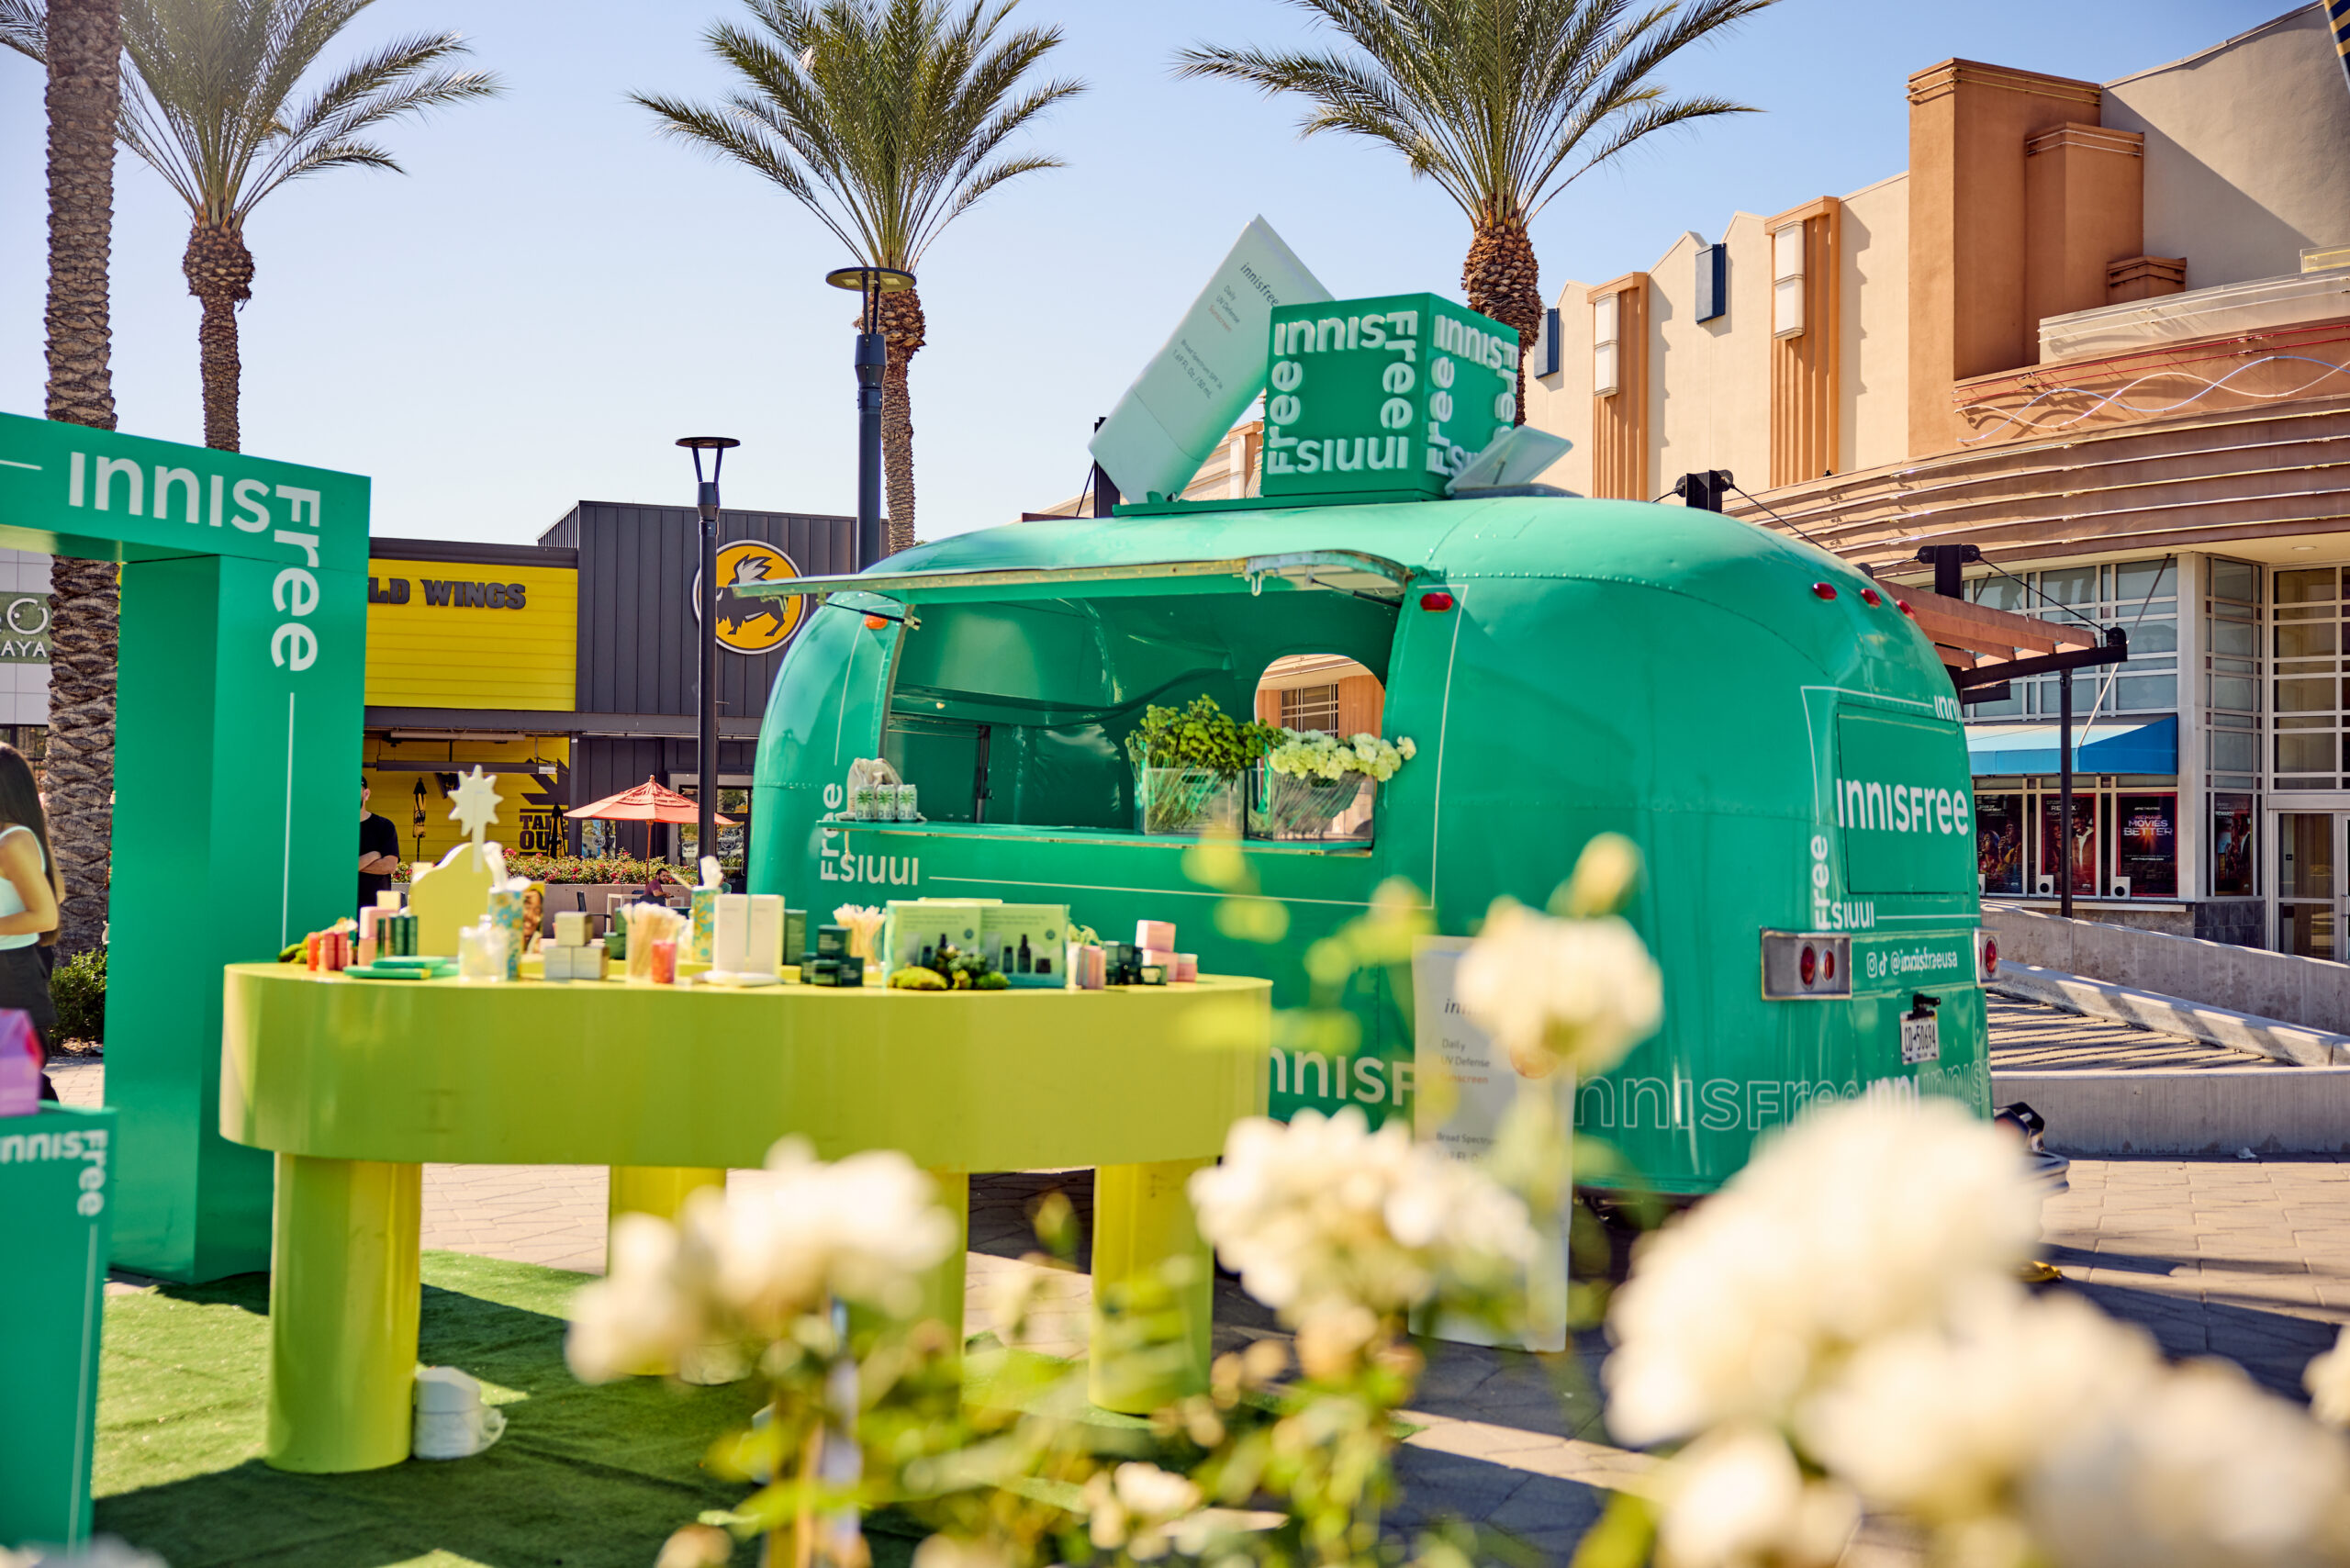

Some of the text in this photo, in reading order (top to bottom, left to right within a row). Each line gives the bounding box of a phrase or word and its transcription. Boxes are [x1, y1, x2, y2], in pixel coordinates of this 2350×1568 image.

[1241, 261, 1280, 307] innisfree
[420, 579, 527, 610] WINGS
[2123, 828, 2173, 836] BETTER
